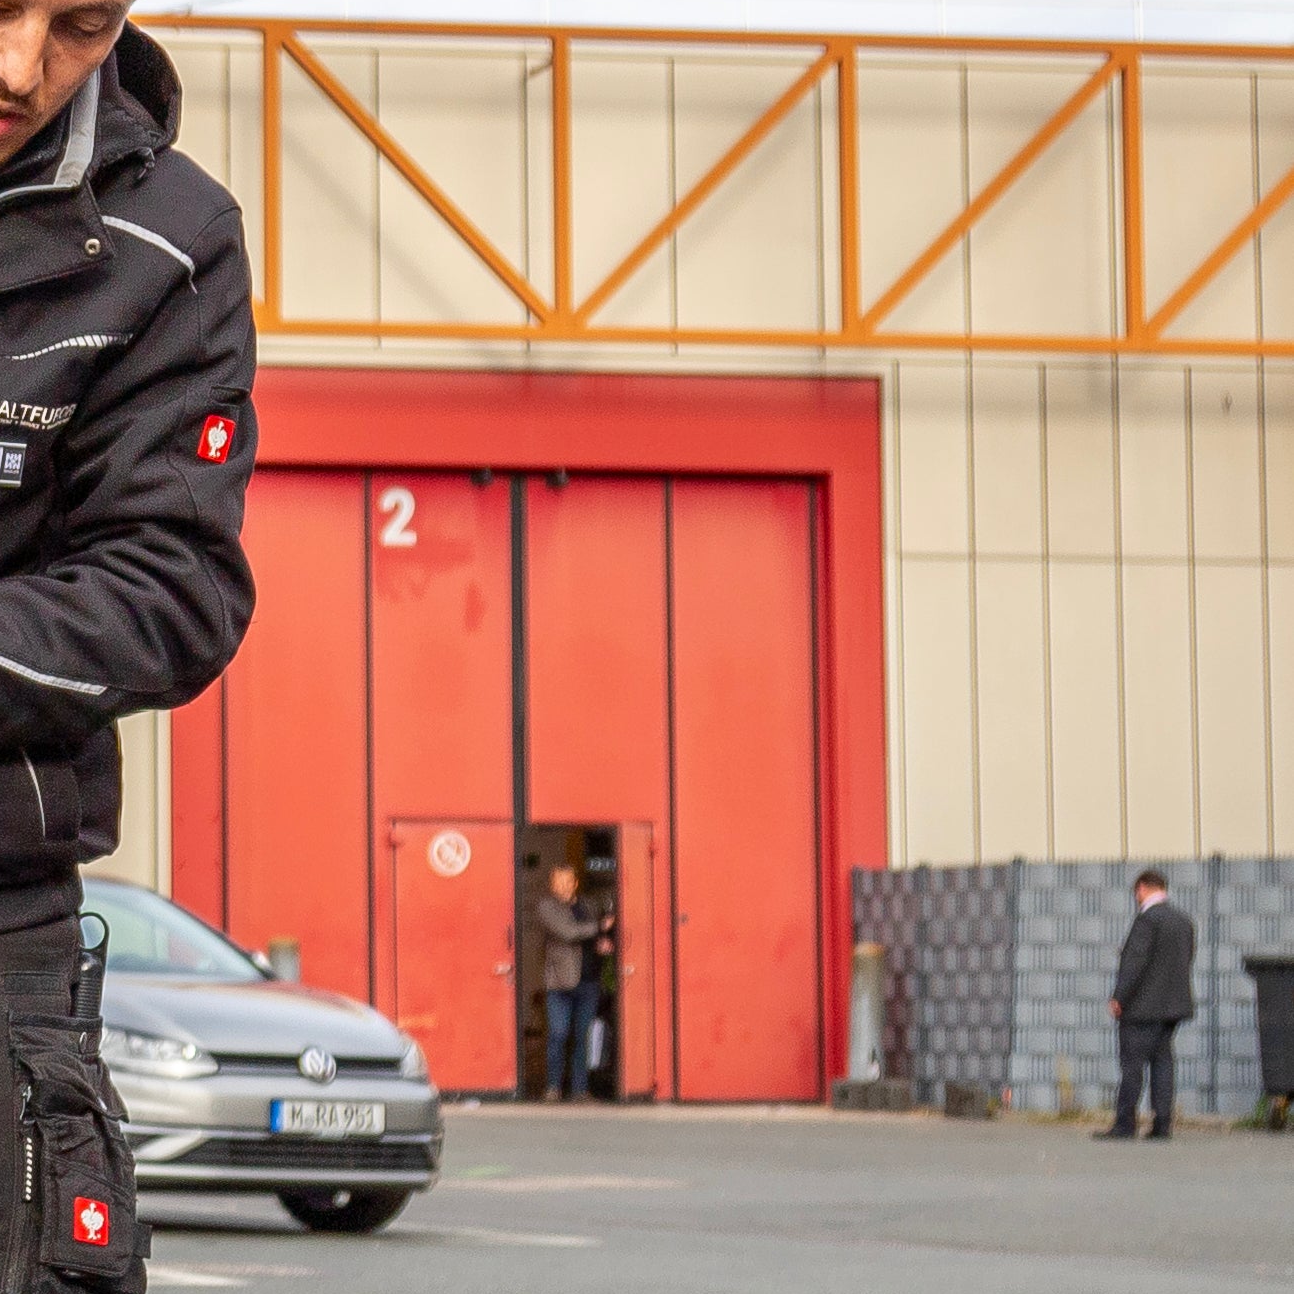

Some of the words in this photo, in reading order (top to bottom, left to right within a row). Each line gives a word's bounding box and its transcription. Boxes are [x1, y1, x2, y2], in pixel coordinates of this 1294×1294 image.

[379, 486, 418, 547] 2
[291, 1104, 303, 1127] M
[316, 1104, 339, 1127] RA
